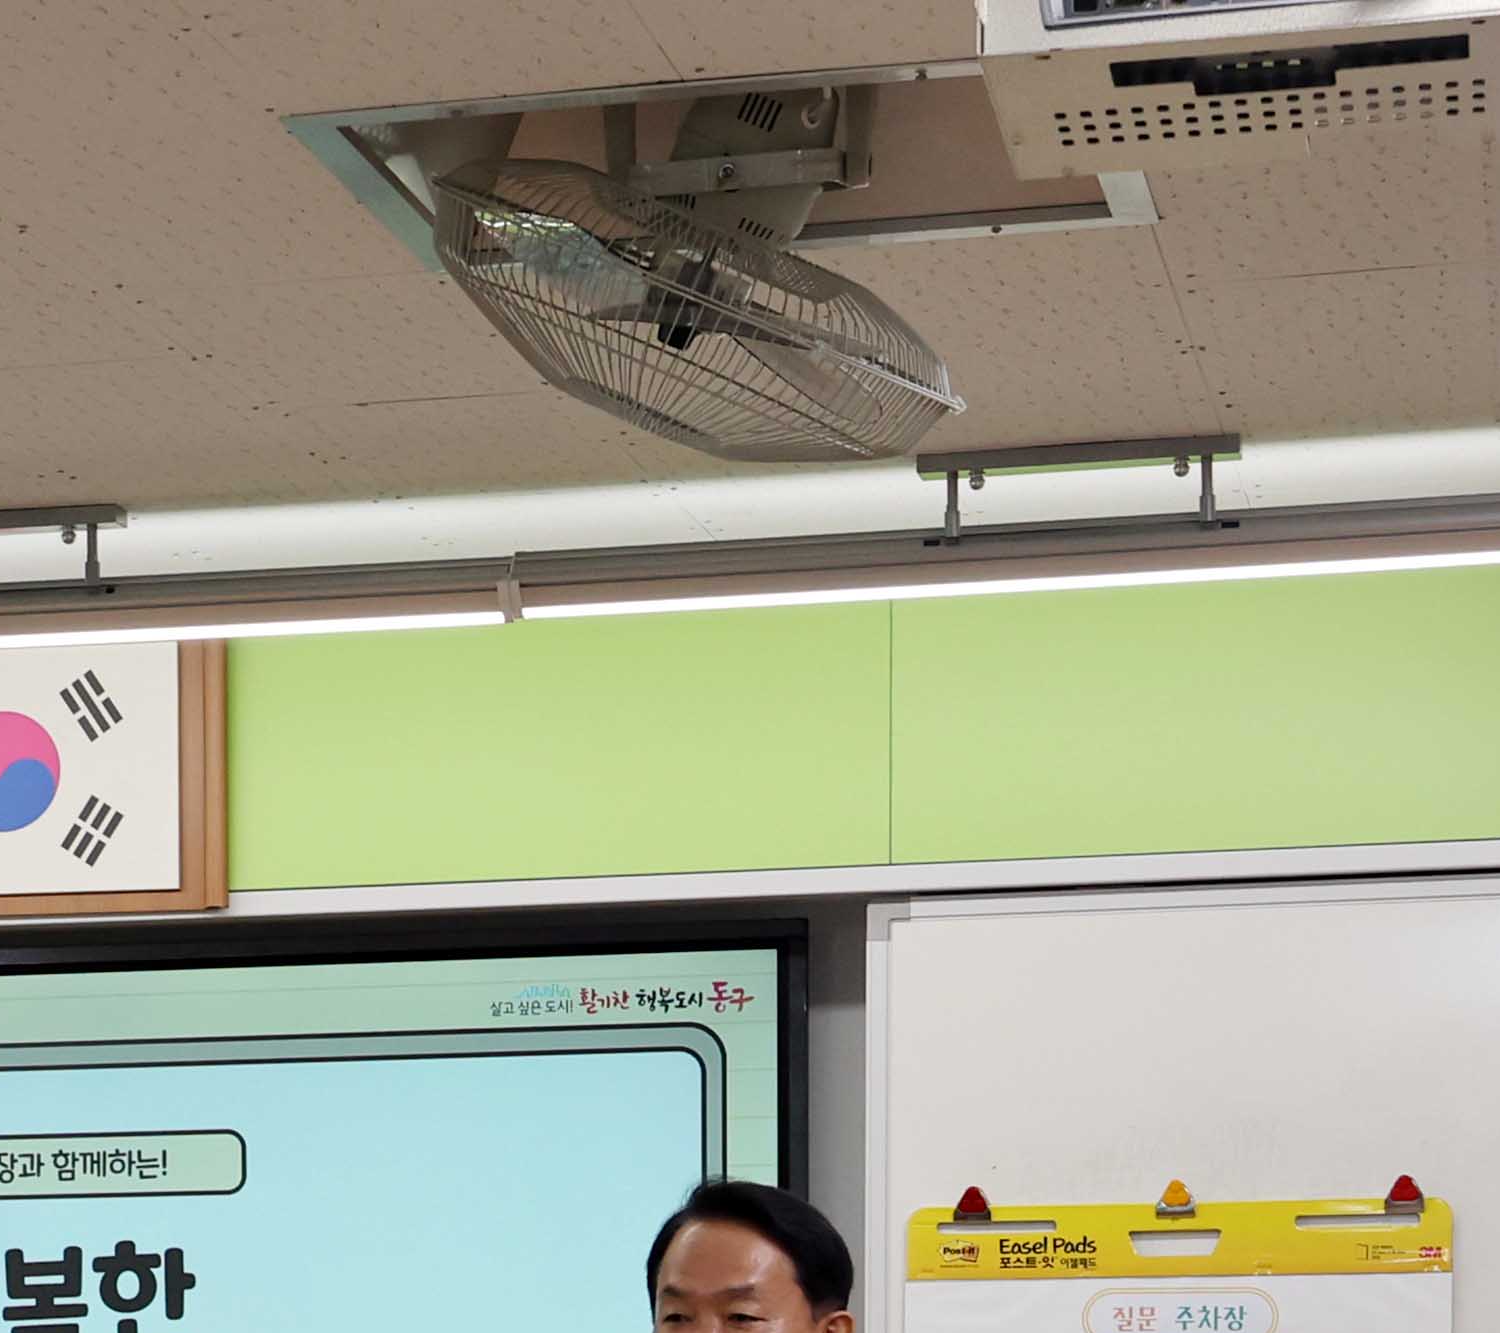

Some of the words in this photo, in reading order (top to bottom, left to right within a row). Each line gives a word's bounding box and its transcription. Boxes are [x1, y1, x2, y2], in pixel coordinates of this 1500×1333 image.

[579, 987, 630, 1014] 활기찬
[636, 987, 703, 1014] 행복도시
[707, 981, 754, 1014] 동구
[51, 1149, 169, 1182] 함께하는!
[999, 1237, 1048, 1255] Easel
[1052, 1235, 1097, 1255] Pads
[1113, 1306, 1158, 1332] 질문
[1175, 1305, 1248, 1332] 주차장
